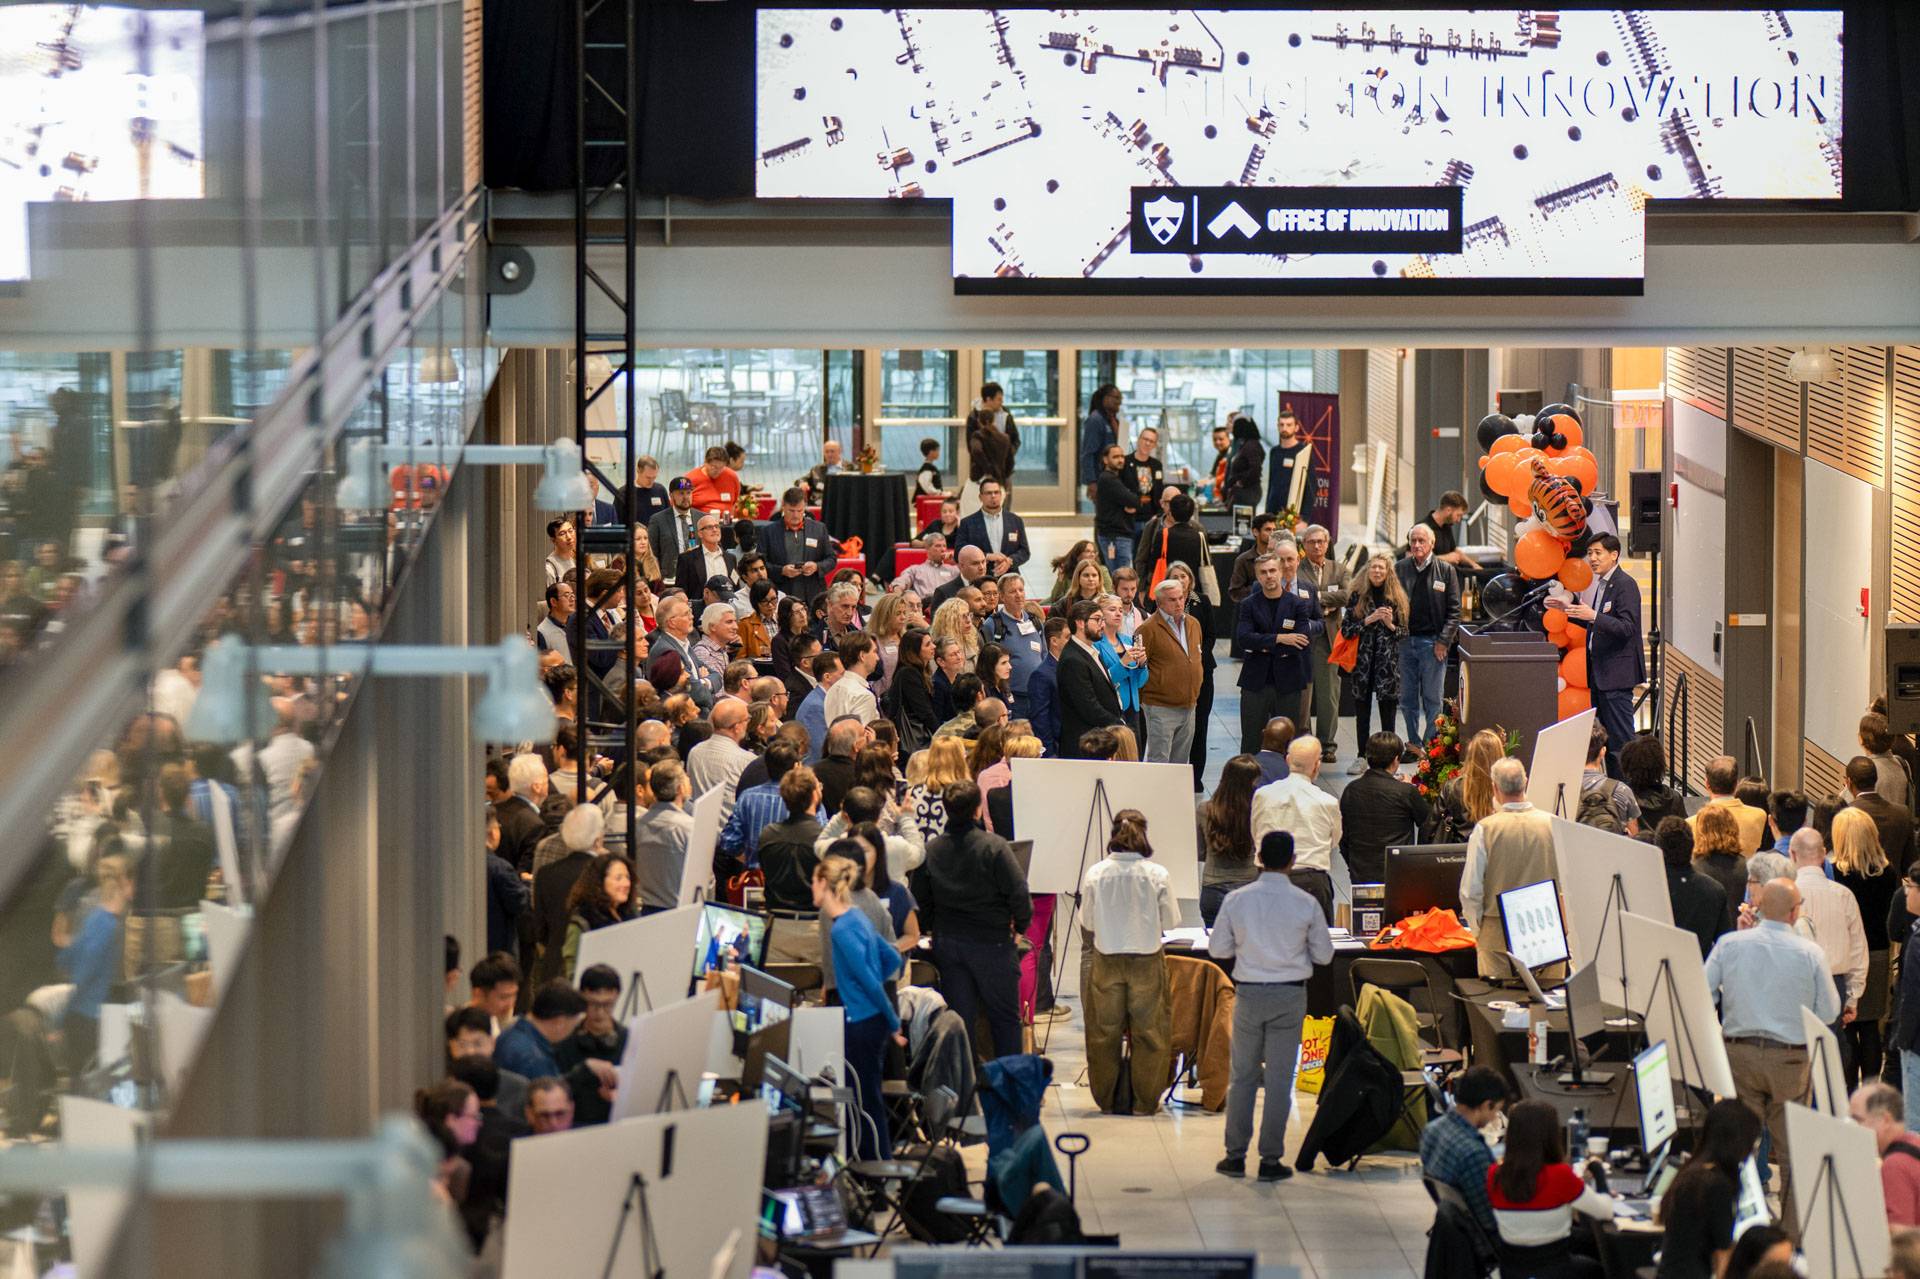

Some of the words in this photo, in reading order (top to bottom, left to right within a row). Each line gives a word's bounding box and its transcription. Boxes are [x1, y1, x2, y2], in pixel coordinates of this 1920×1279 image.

[1267, 208, 1325, 232] OFFICE
[1326, 208, 1348, 232] OF
[1350, 208, 1450, 232] INNOVATION
[1301, 1037, 1319, 1050] OT
[1301, 1048, 1326, 1064] ONE
